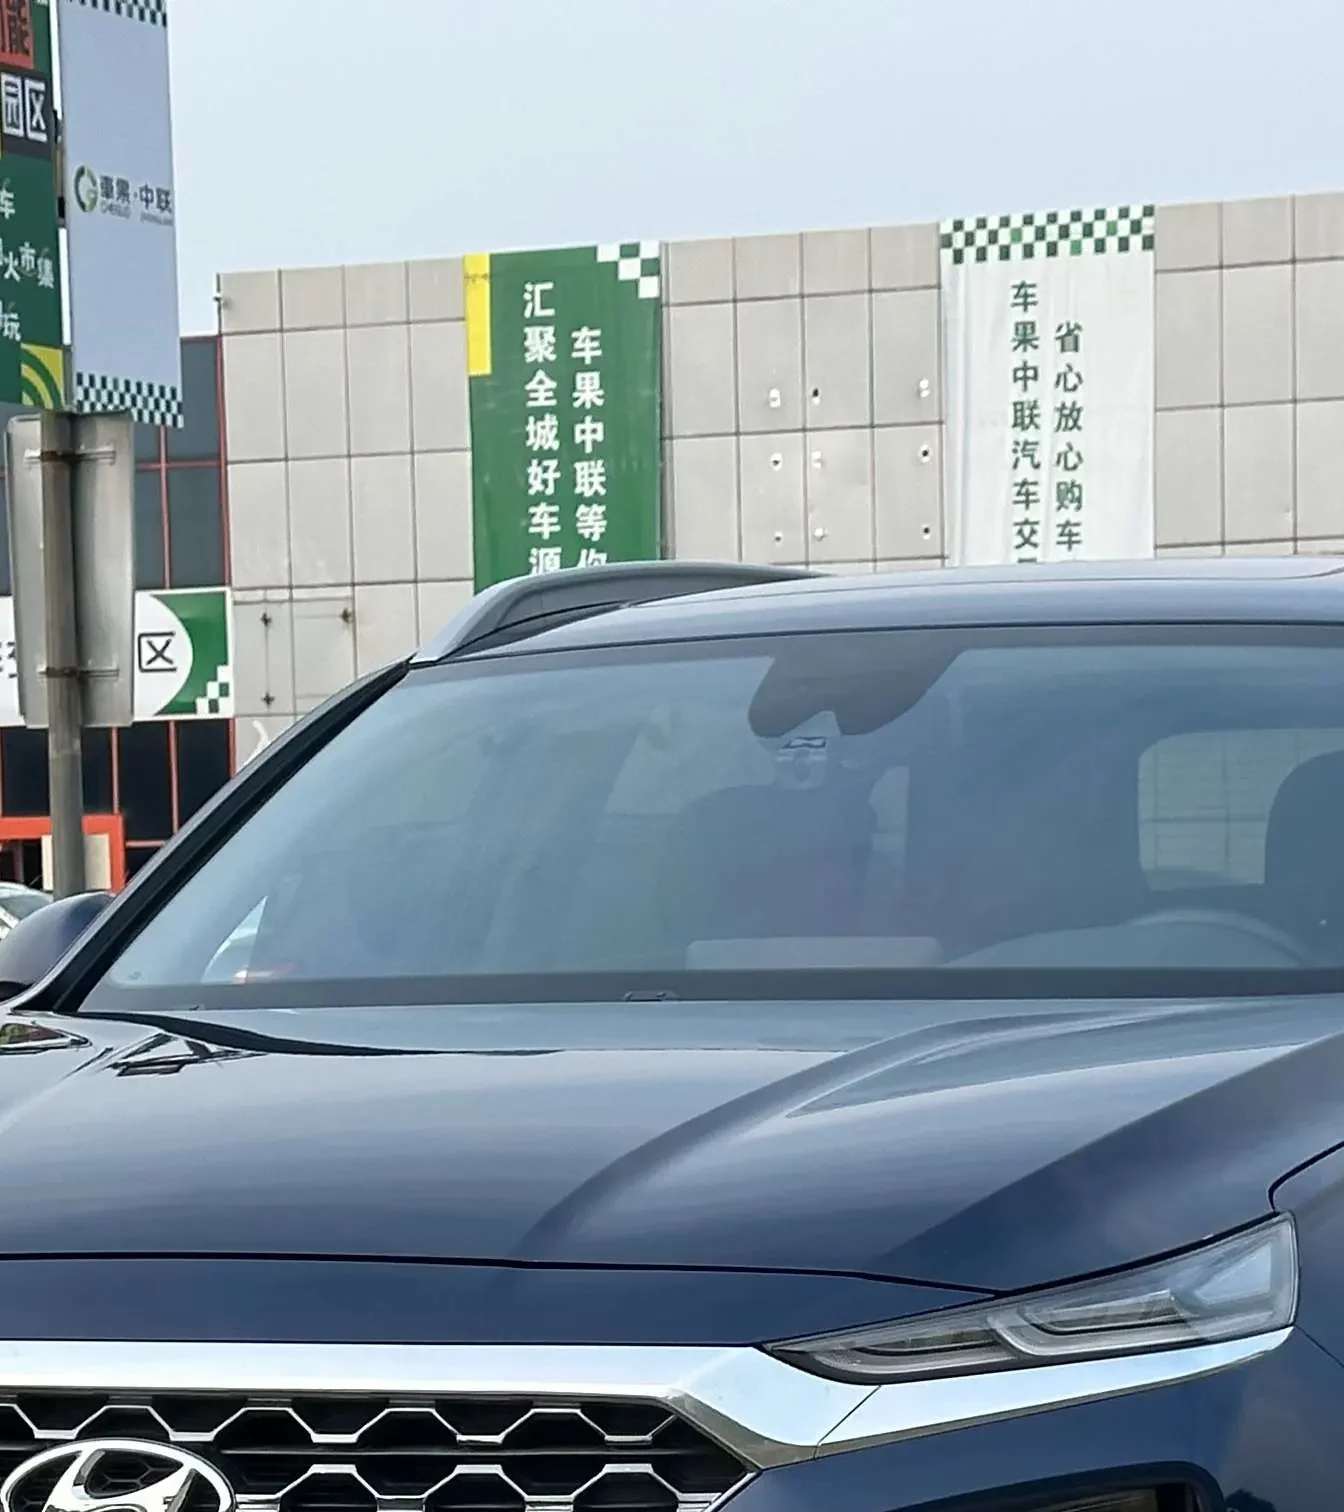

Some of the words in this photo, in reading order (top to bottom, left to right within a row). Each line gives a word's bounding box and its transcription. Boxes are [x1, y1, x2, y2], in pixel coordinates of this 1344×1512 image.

[523, 281, 562, 574] 汇聚全城好车源
[1010, 280, 1041, 563] 车果中联汽车交
[1054, 321, 1084, 551] 省心放心购车
